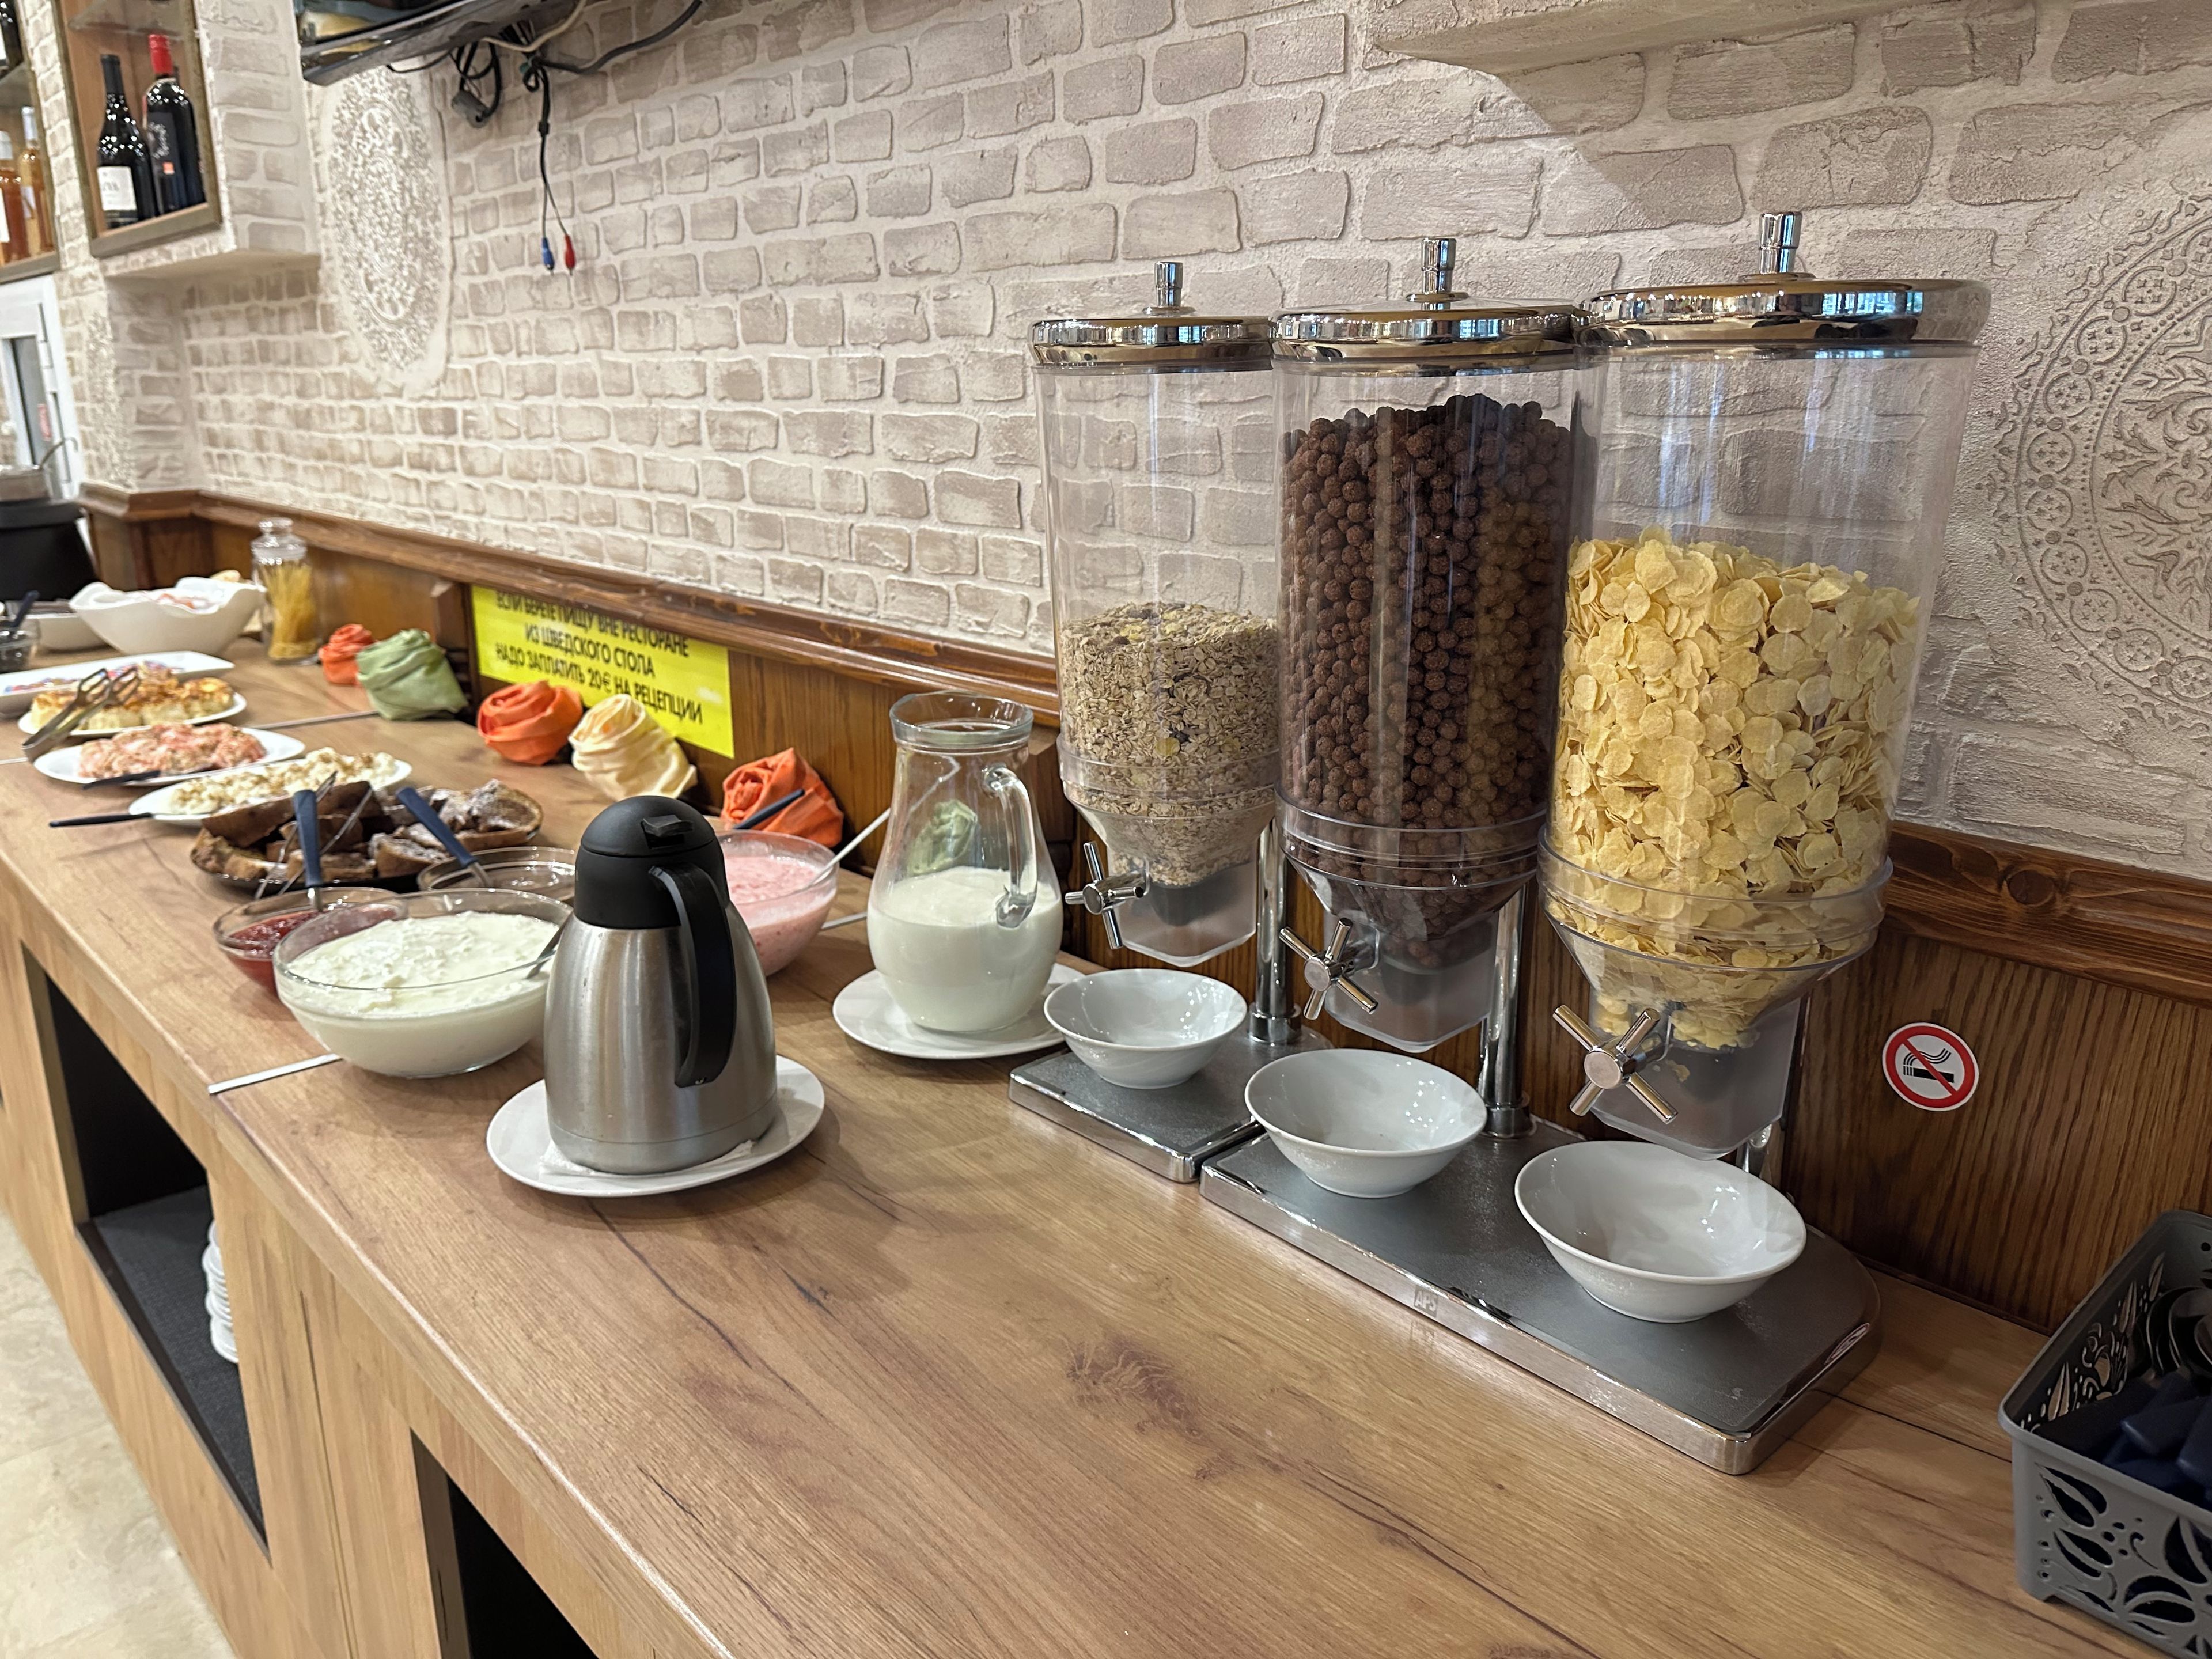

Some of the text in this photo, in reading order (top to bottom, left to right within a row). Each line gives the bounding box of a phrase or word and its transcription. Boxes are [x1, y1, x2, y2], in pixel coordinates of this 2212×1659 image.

[525, 622, 656, 679] ИЗ ШВЕДСКОГО СТОЛА
[559, 605, 595, 633] ПИЩУ
[622, 620, 690, 658] РЕСТОРАНЕ
[495, 642, 703, 725] НАДО ЗАПЛАТИТЬ 20€ НА РЕЦЕПЦИИ
[1415, 1290, 1437, 1312] APS
